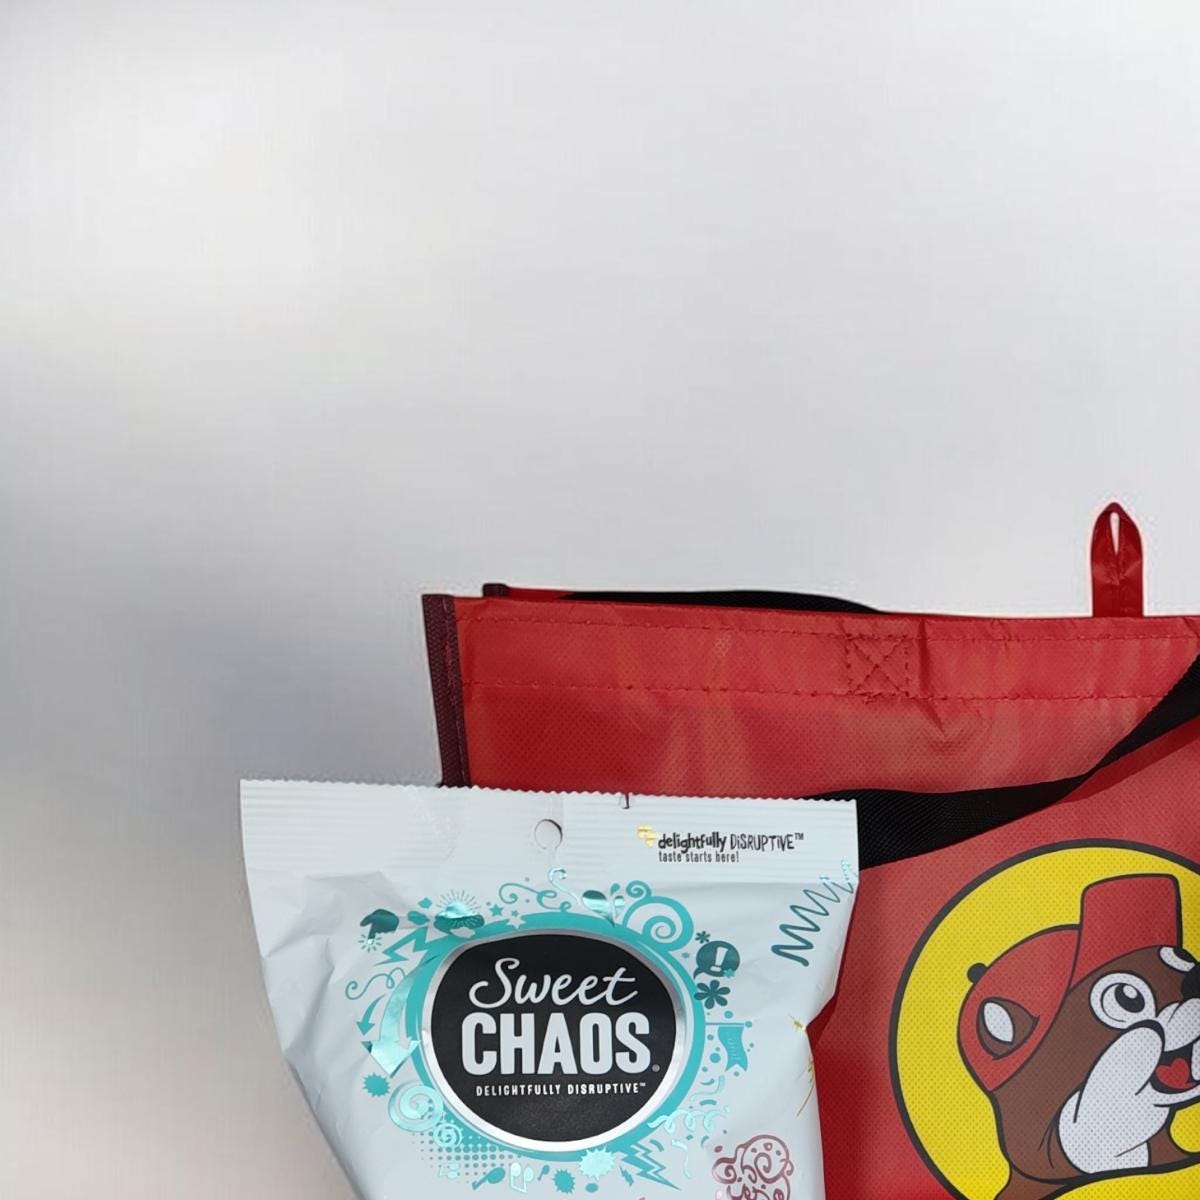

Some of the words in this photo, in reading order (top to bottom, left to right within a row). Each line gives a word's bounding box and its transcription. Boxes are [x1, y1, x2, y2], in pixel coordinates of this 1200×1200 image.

[658, 832, 727, 853] delightfully
[659, 851, 682, 863] taste
[685, 851, 712, 863] starts
[715, 851, 740, 863] here!
[468, 957, 639, 1009] Sweet
[461, 1011, 651, 1076] CHAOS
[476, 1084, 561, 1097] DELIGHTFULLY
